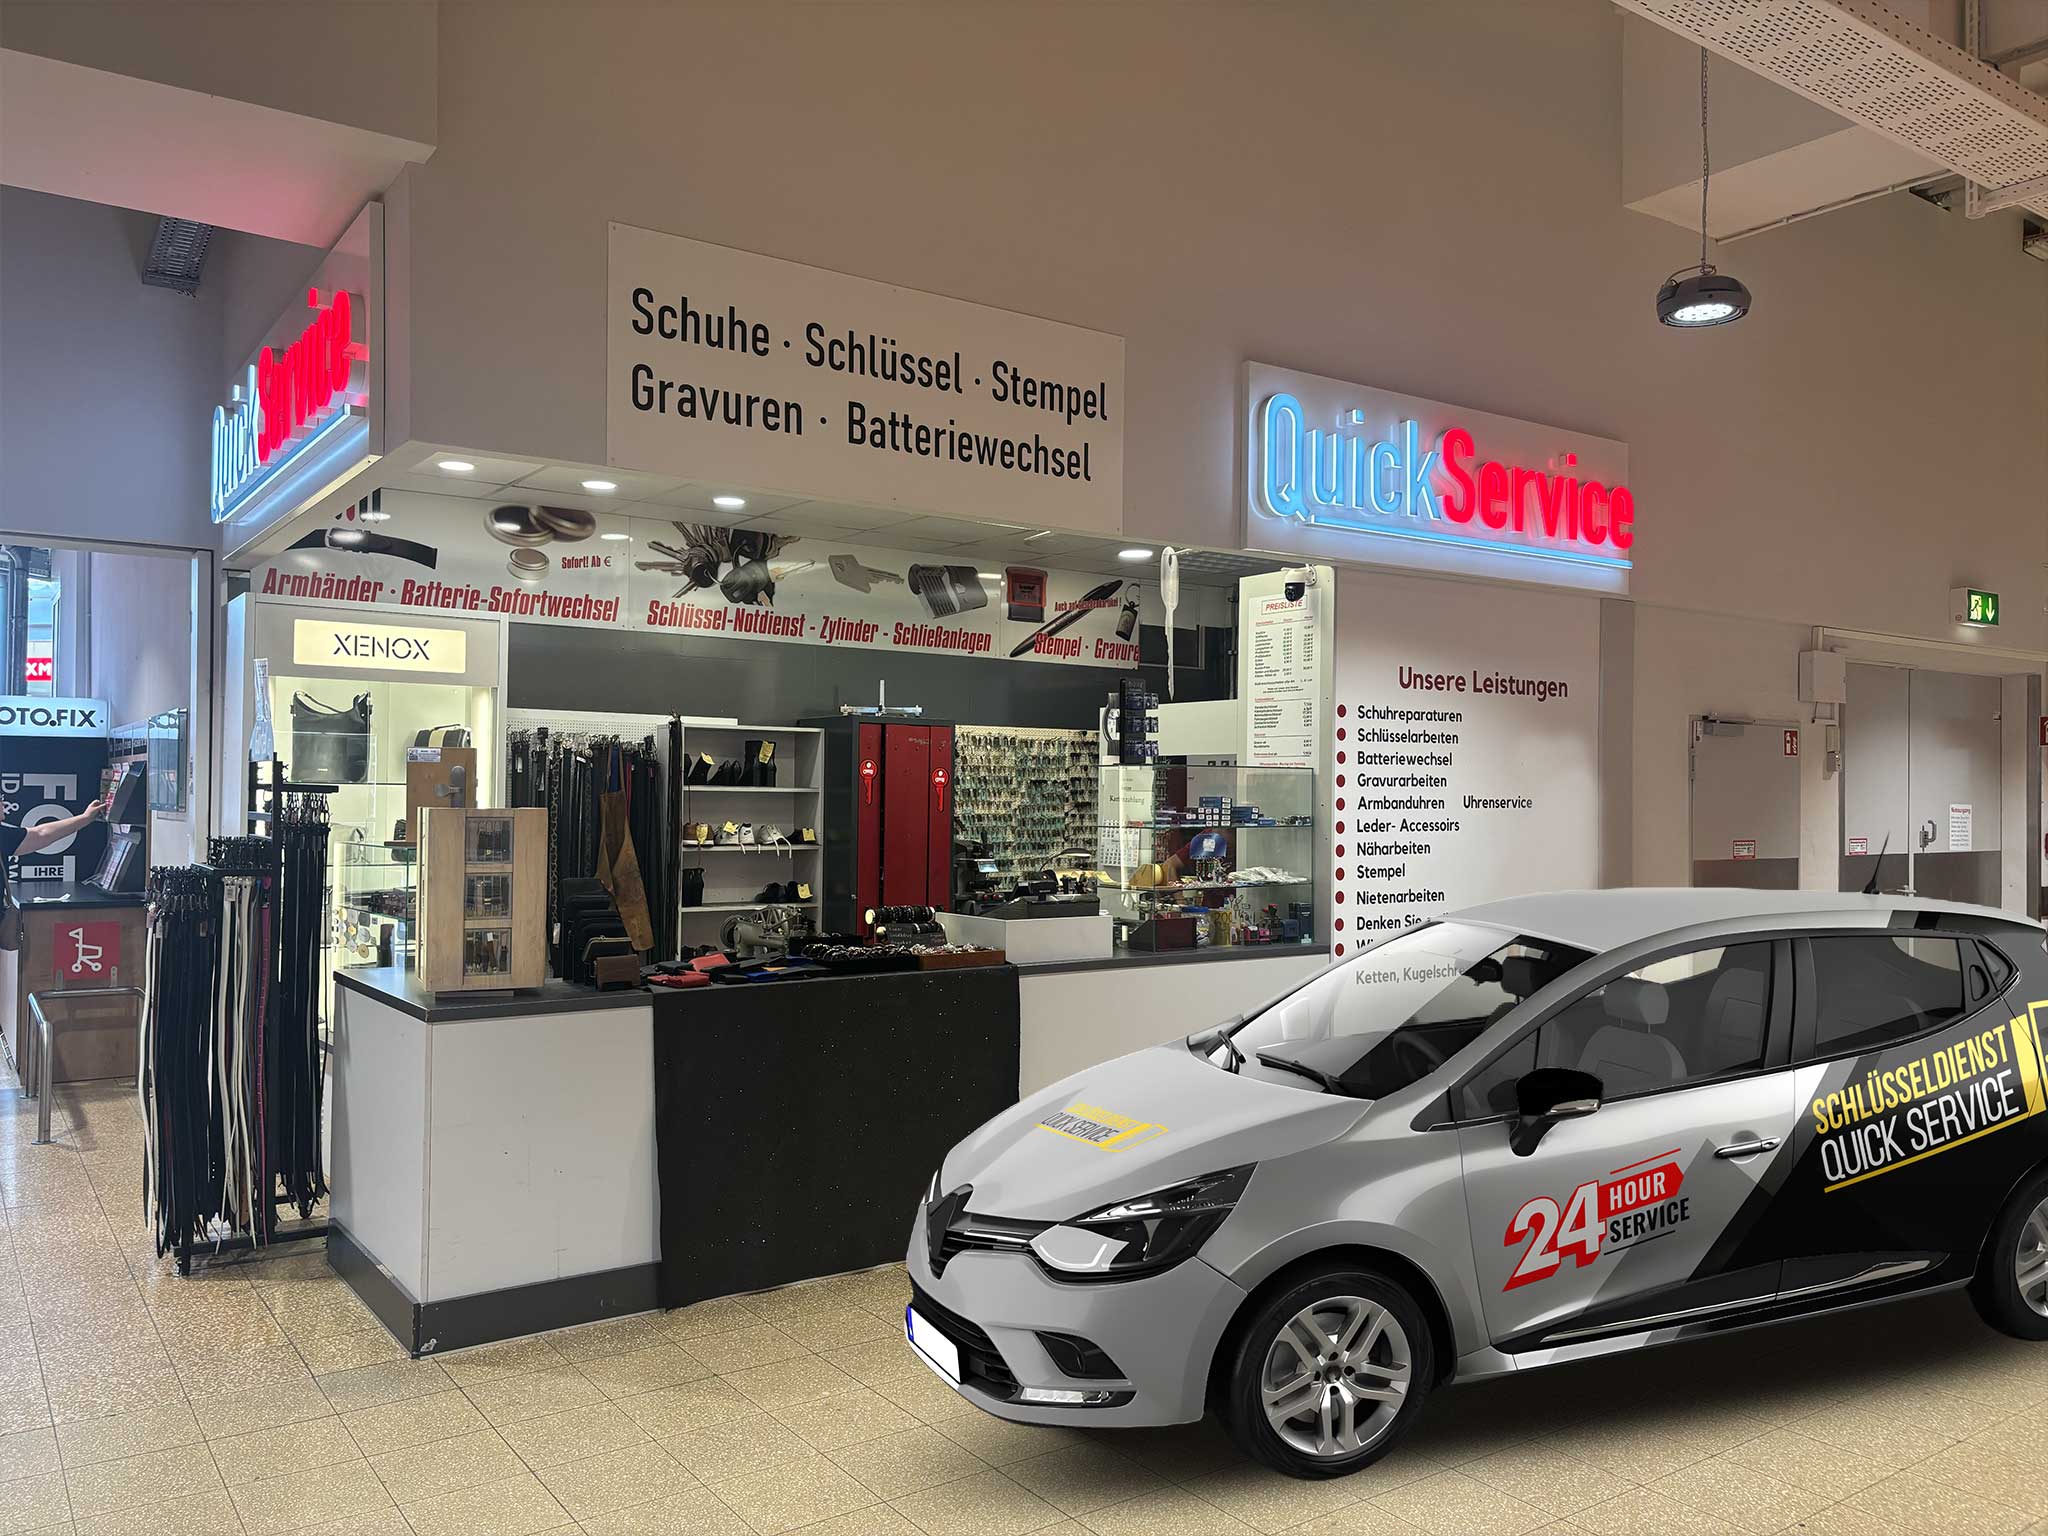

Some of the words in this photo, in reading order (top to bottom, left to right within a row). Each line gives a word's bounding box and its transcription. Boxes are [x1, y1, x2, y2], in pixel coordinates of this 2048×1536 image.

[631, 287, 770, 357] Schuhe
[805, 322, 963, 395] Schlüssel
[991, 359, 1108, 425] Stempel
[631, 363, 803, 436] Gravuren
[847, 400, 1091, 482] Batteriewechsel
[561, 556, 589, 570] Sofort!
[591, 556, 601, 568] Ab
[262, 567, 383, 603] Armbänder
[400, 579, 620, 622] Batterie-Sofortwechsel
[646, 599, 806, 638] Schlüssel-Notdienst
[819, 616, 879, 645] Zylinder
[893, 621, 992, 654] Schließanlagen
[333, 633, 430, 661] XENOX
[1034, 631, 1082, 660] Stempel
[1399, 666, 1466, 692] Unsere
[1472, 670, 1569, 702] Leistungen
[1357, 704, 1462, 724] Schuhreparaturen
[1357, 728, 1459, 745] Schlüsselarbeiten
[1357, 751, 1453, 767] Batteriewechsel
[1357, 773, 1448, 788] Gravurarbeiten
[1357, 795, 1445, 811] Armbanduhren
[1463, 795, 1533, 809] Uhrenservice
[1356, 818, 1396, 833] Leder-
[1399, 817, 1460, 832] Accessoirs
[1356, 841, 1431, 856] Näharbeiten
[1356, 863, 1406, 881] Stempel
[1356, 889, 1445, 905] Nietenarbeiten
[1356, 915, 1401, 930] Denken
[1356, 968, 1400, 985] Ketten,
[1812, 1024, 2009, 1135] SCHLÜSSELDIENST
[1820, 1115, 1905, 1182] QUICK
[1906, 1069, 2020, 1151] SERVICE
[1609, 1197, 1690, 1243] SERVICE
[1504, 1180, 1607, 1290] 24
[1609, 1171, 1666, 1211] HOUR
